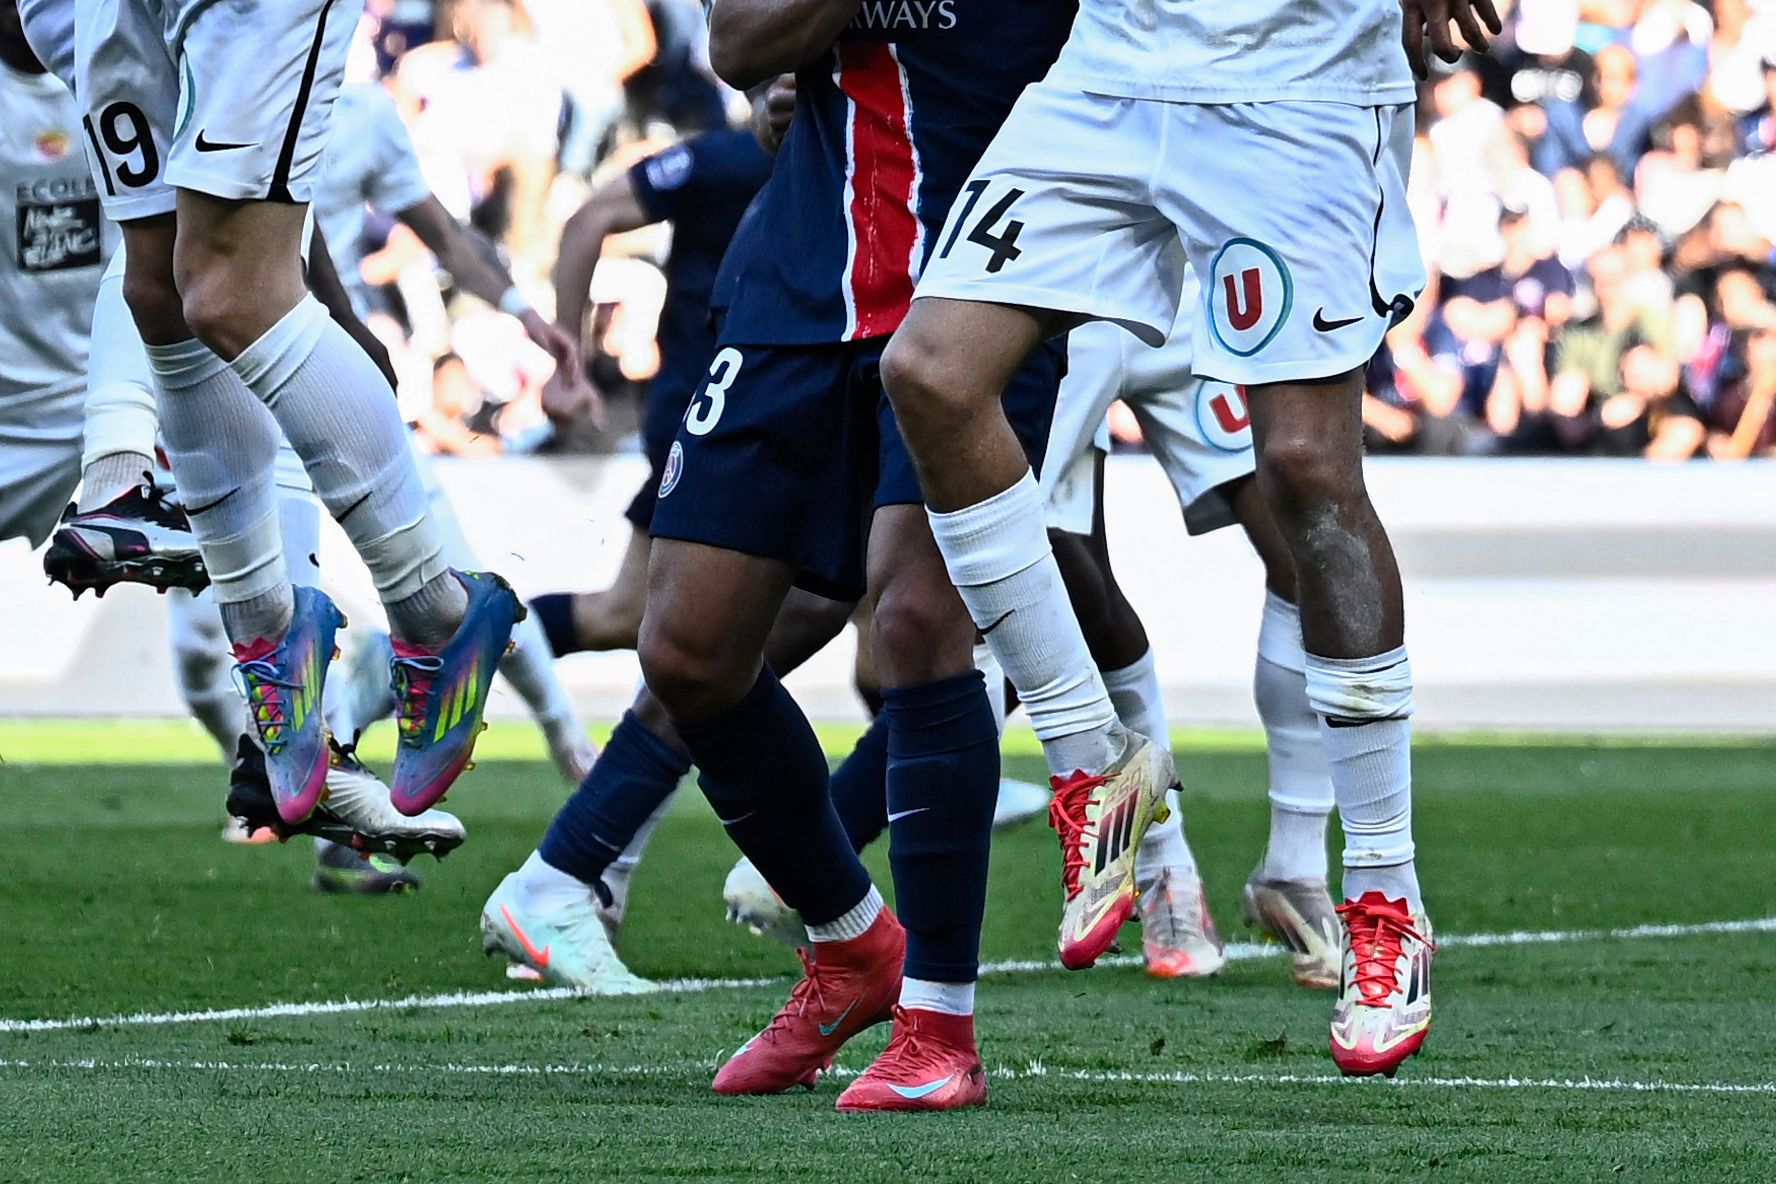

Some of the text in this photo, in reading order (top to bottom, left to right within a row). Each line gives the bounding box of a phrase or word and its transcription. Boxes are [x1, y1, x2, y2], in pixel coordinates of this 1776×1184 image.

[849, 0, 957, 29] WAYS
[83, 101, 160, 196] 19
[939, 179, 1026, 273] 14
[1223, 267, 1263, 331] U
[683, 347, 743, 436] 3
[1208, 384, 1250, 433] U
